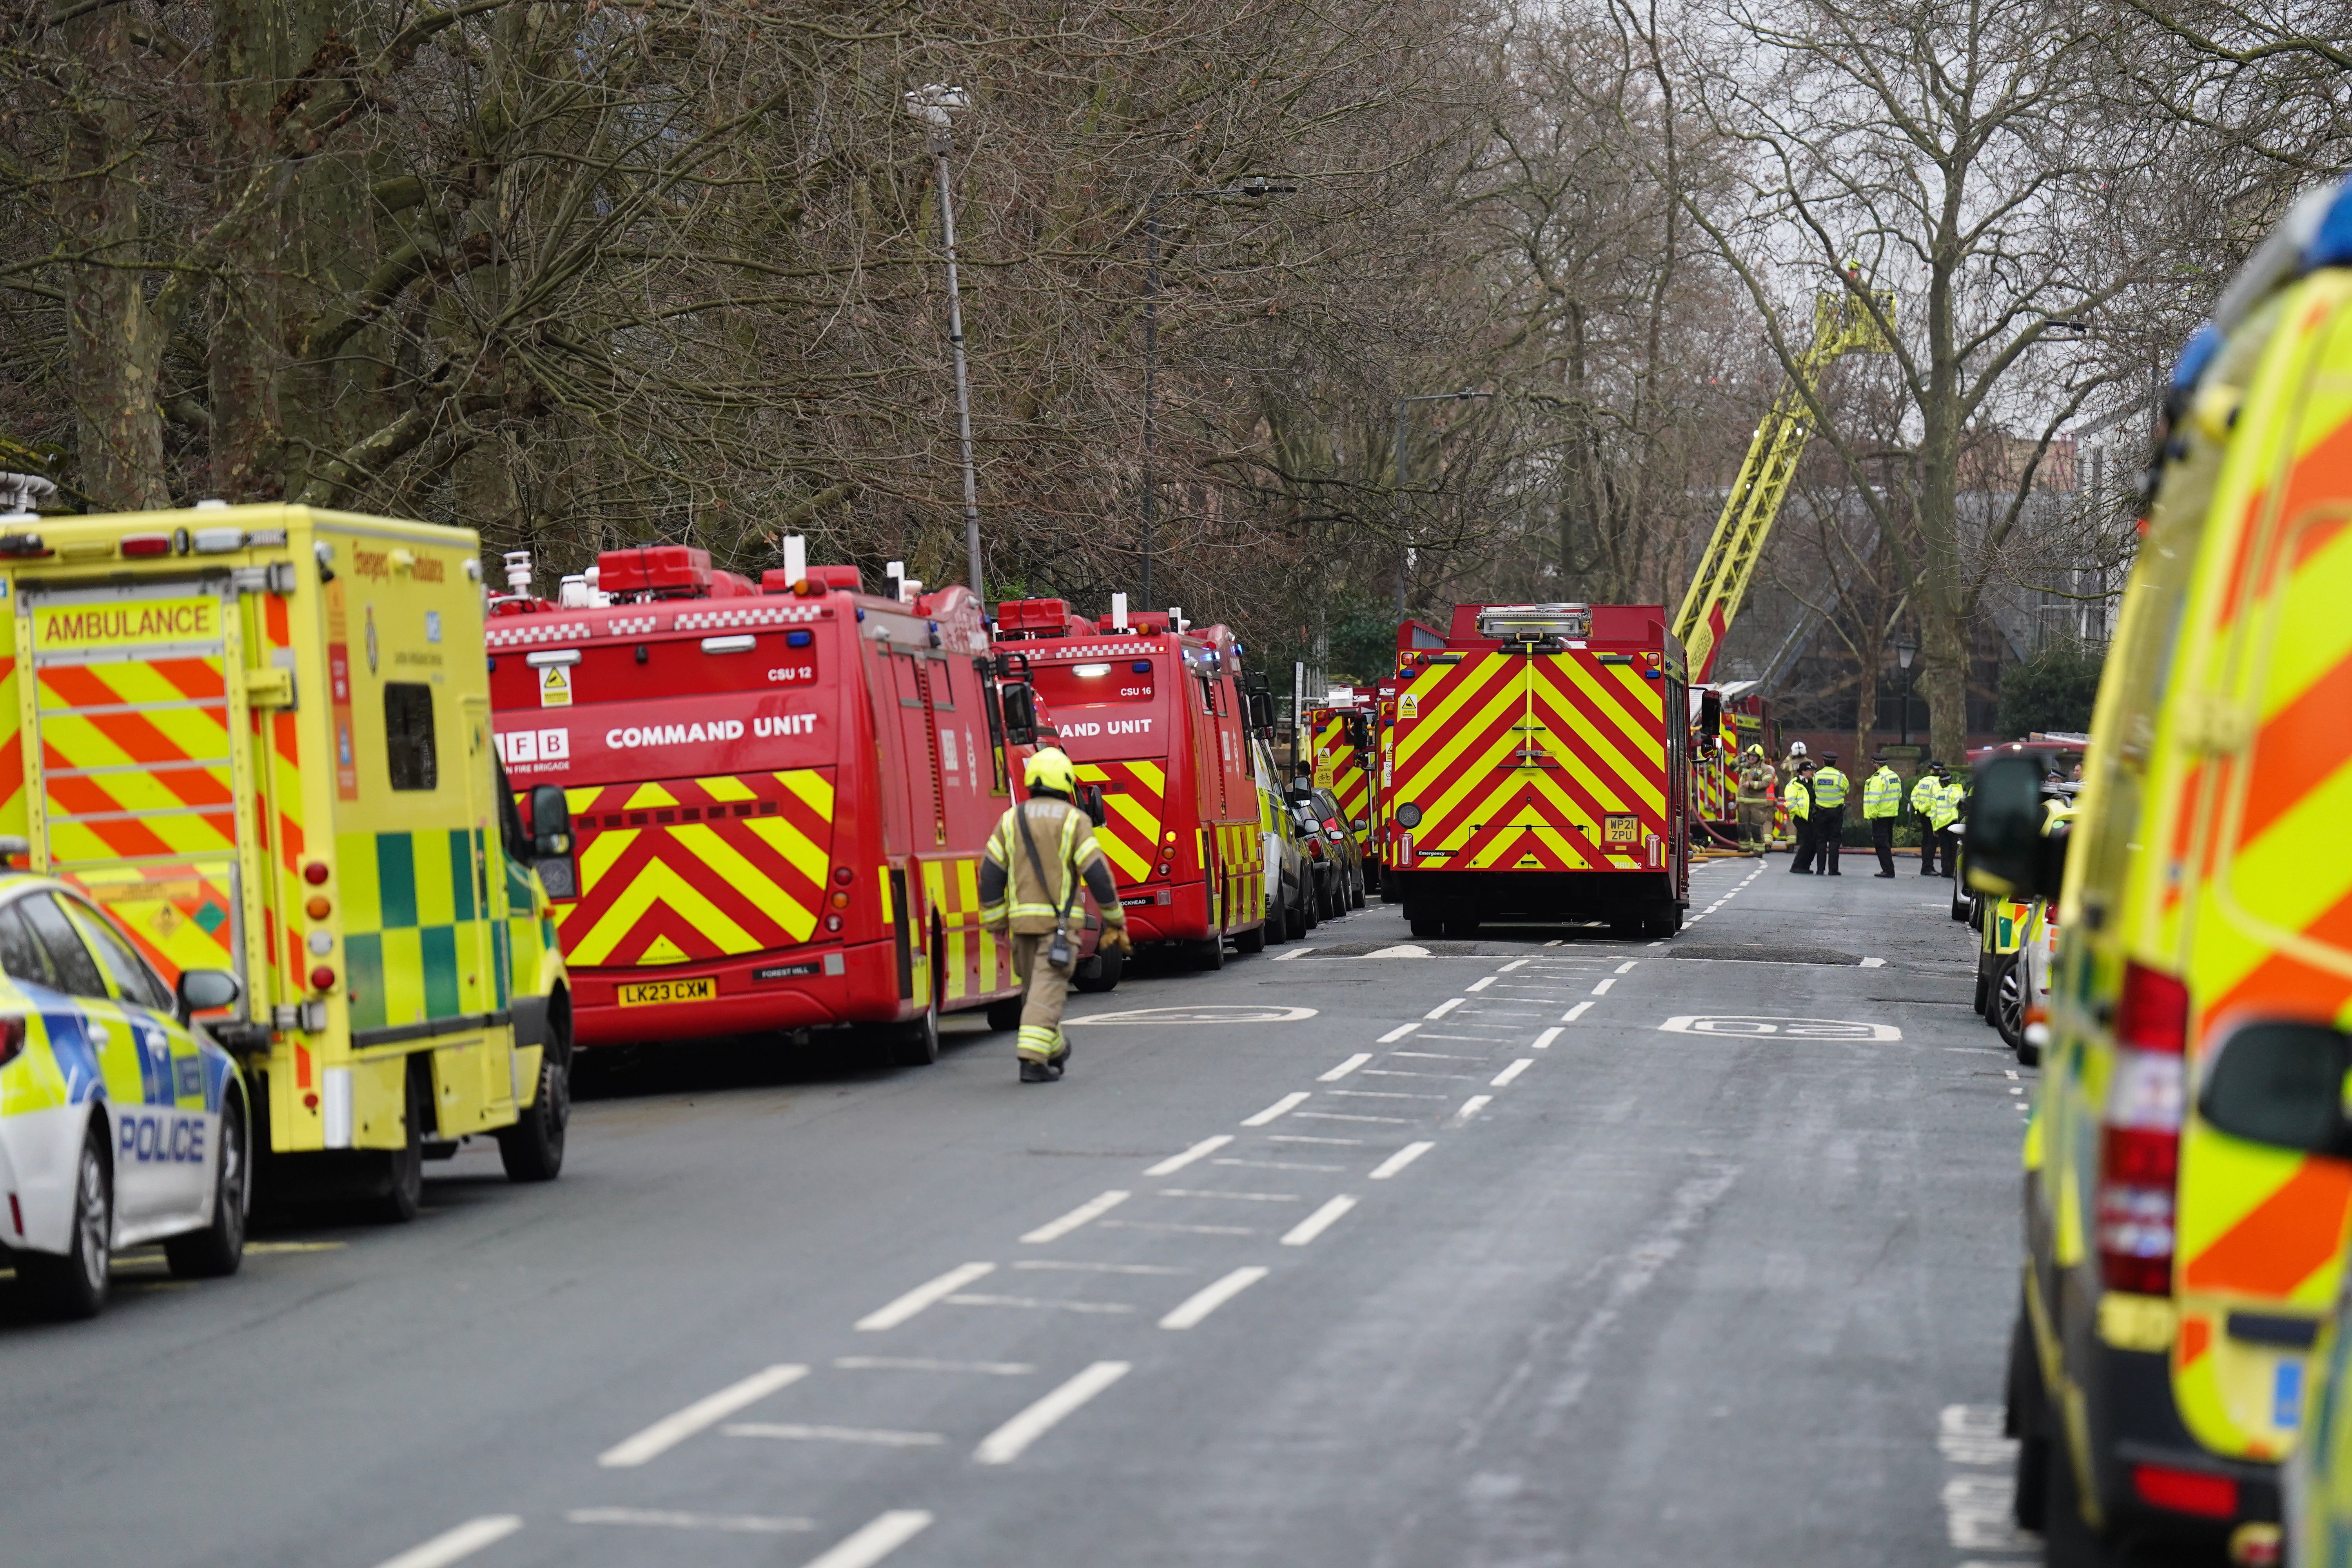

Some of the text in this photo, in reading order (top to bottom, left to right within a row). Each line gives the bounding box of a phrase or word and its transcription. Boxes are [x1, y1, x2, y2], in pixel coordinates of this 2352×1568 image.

[46, 605, 209, 642] AMBULANCE
[768, 666, 812, 682] CSU 12
[1120, 688, 1139, 696] CSU
[606, 713, 817, 750] COMMAND UNIT
[1107, 719, 1152, 735] UNIT
[514, 764, 532, 774] FIRE
[533, 761, 570, 773] BRIGADE
[1610, 820, 1633, 829] WP21
[1612, 831, 1632, 840] ZPU
[762, 966, 809, 979] FOREST HILL
[627, 981, 708, 1002] LK23 CXM
[119, 1116, 204, 1163] POLICE
